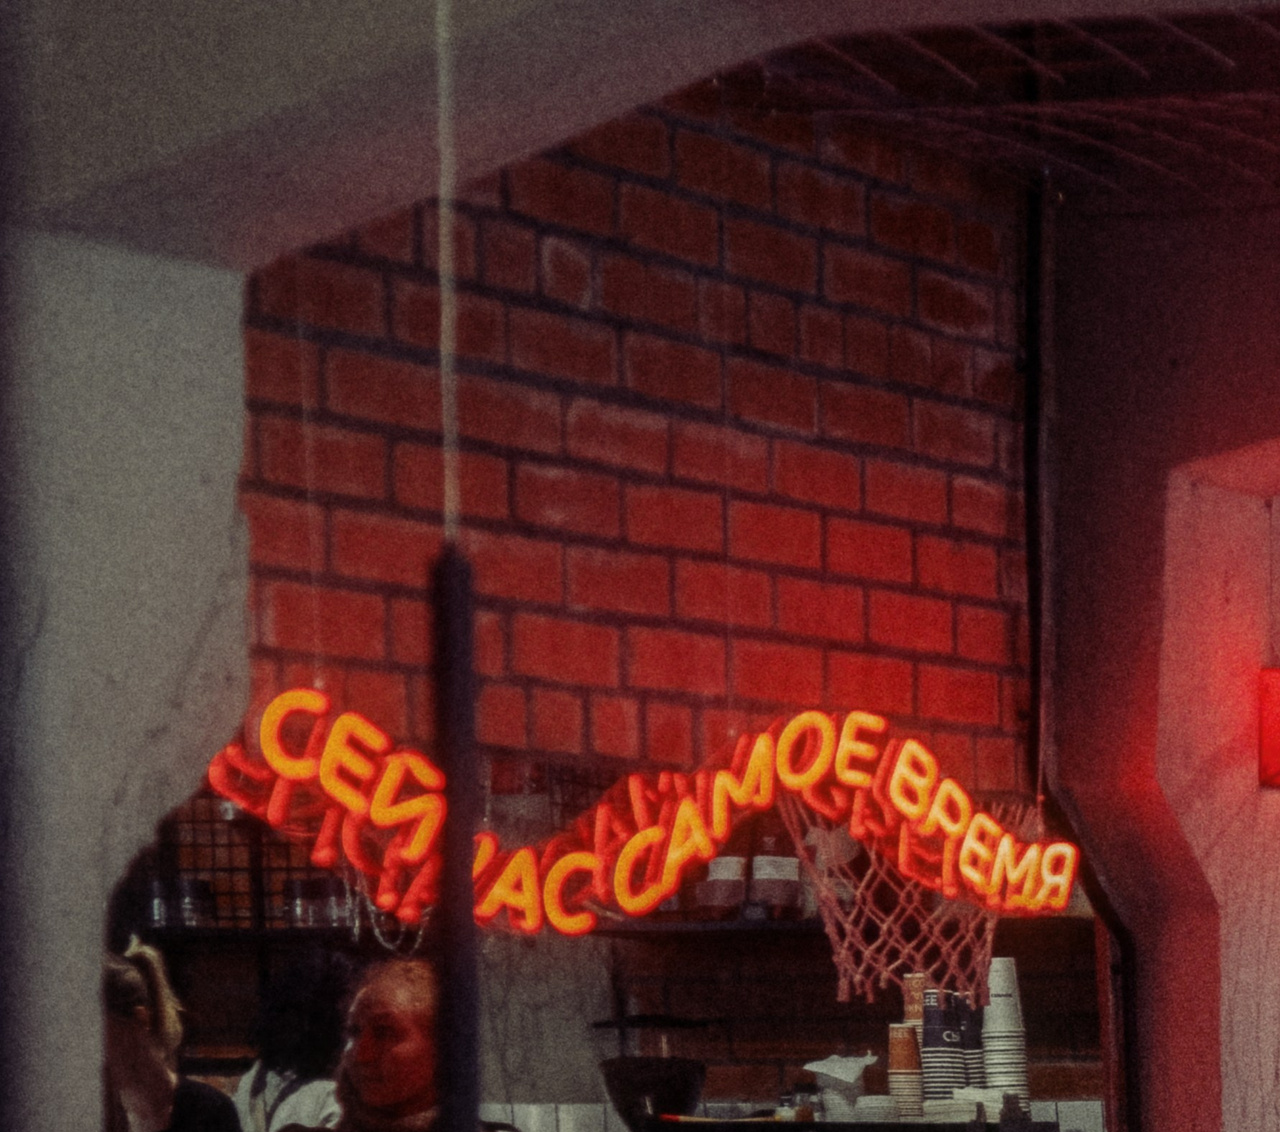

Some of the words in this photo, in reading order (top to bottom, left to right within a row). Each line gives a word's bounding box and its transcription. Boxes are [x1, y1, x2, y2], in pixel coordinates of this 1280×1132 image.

[258, 687, 598, 936] СЕЙАС
[612, 708, 888, 918] САМОЕ
[887, 737, 1080, 915] ВРЕМЯ
